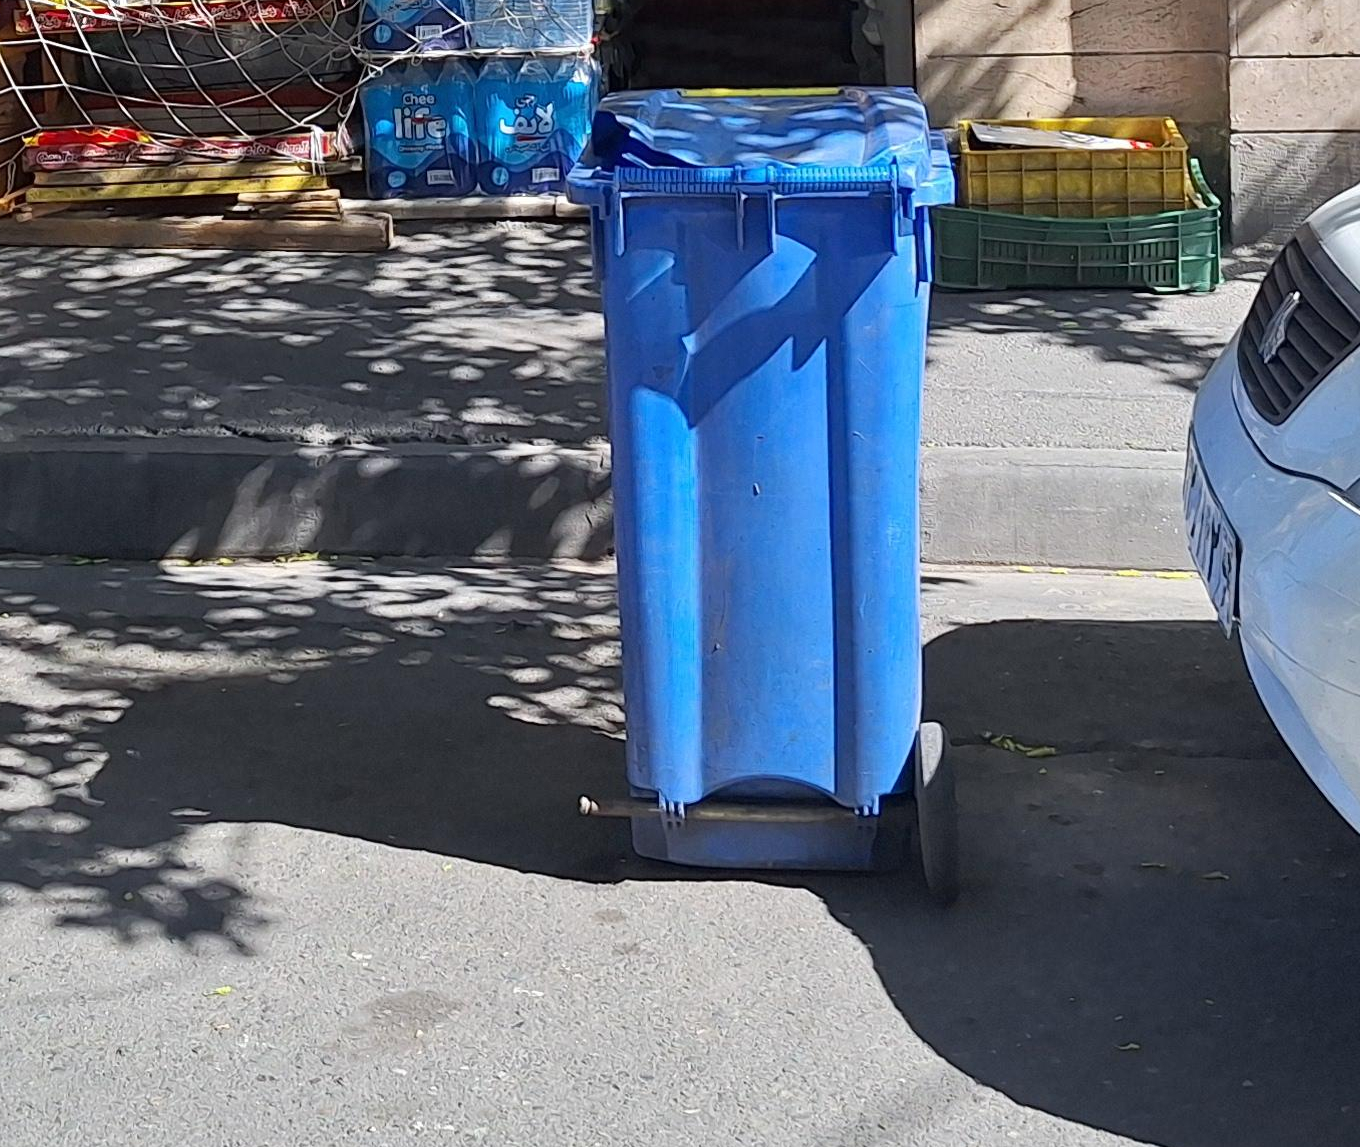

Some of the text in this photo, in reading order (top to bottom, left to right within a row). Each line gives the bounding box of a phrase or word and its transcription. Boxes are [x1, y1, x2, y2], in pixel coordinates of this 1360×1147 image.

[402, 93, 435, 106] Chee
[393, 107, 447, 141] life
[498, 102, 554, 136] لایف
